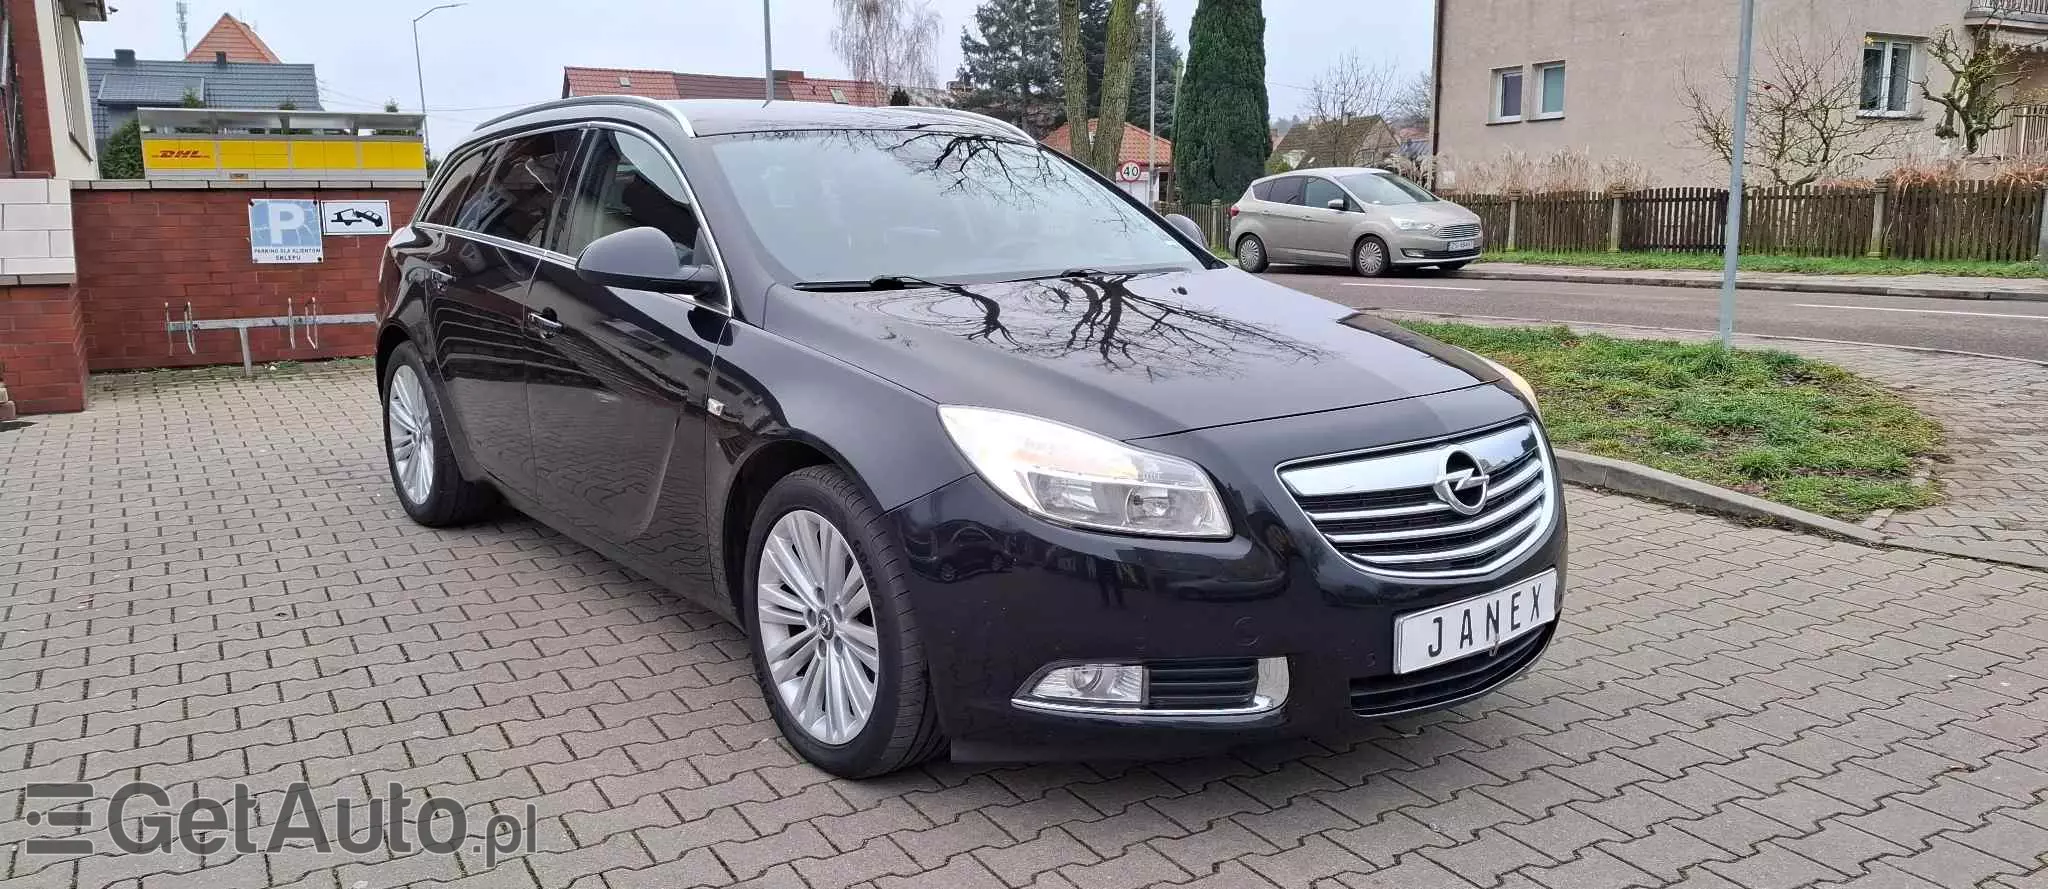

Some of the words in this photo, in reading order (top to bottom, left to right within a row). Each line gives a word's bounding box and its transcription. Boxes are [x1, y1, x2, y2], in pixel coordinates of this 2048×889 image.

[156, 150, 205, 159] DHL
[1123, 166, 1139, 177] 40
[268, 202, 305, 245] P
[1428, 583, 1542, 658] JANEX
